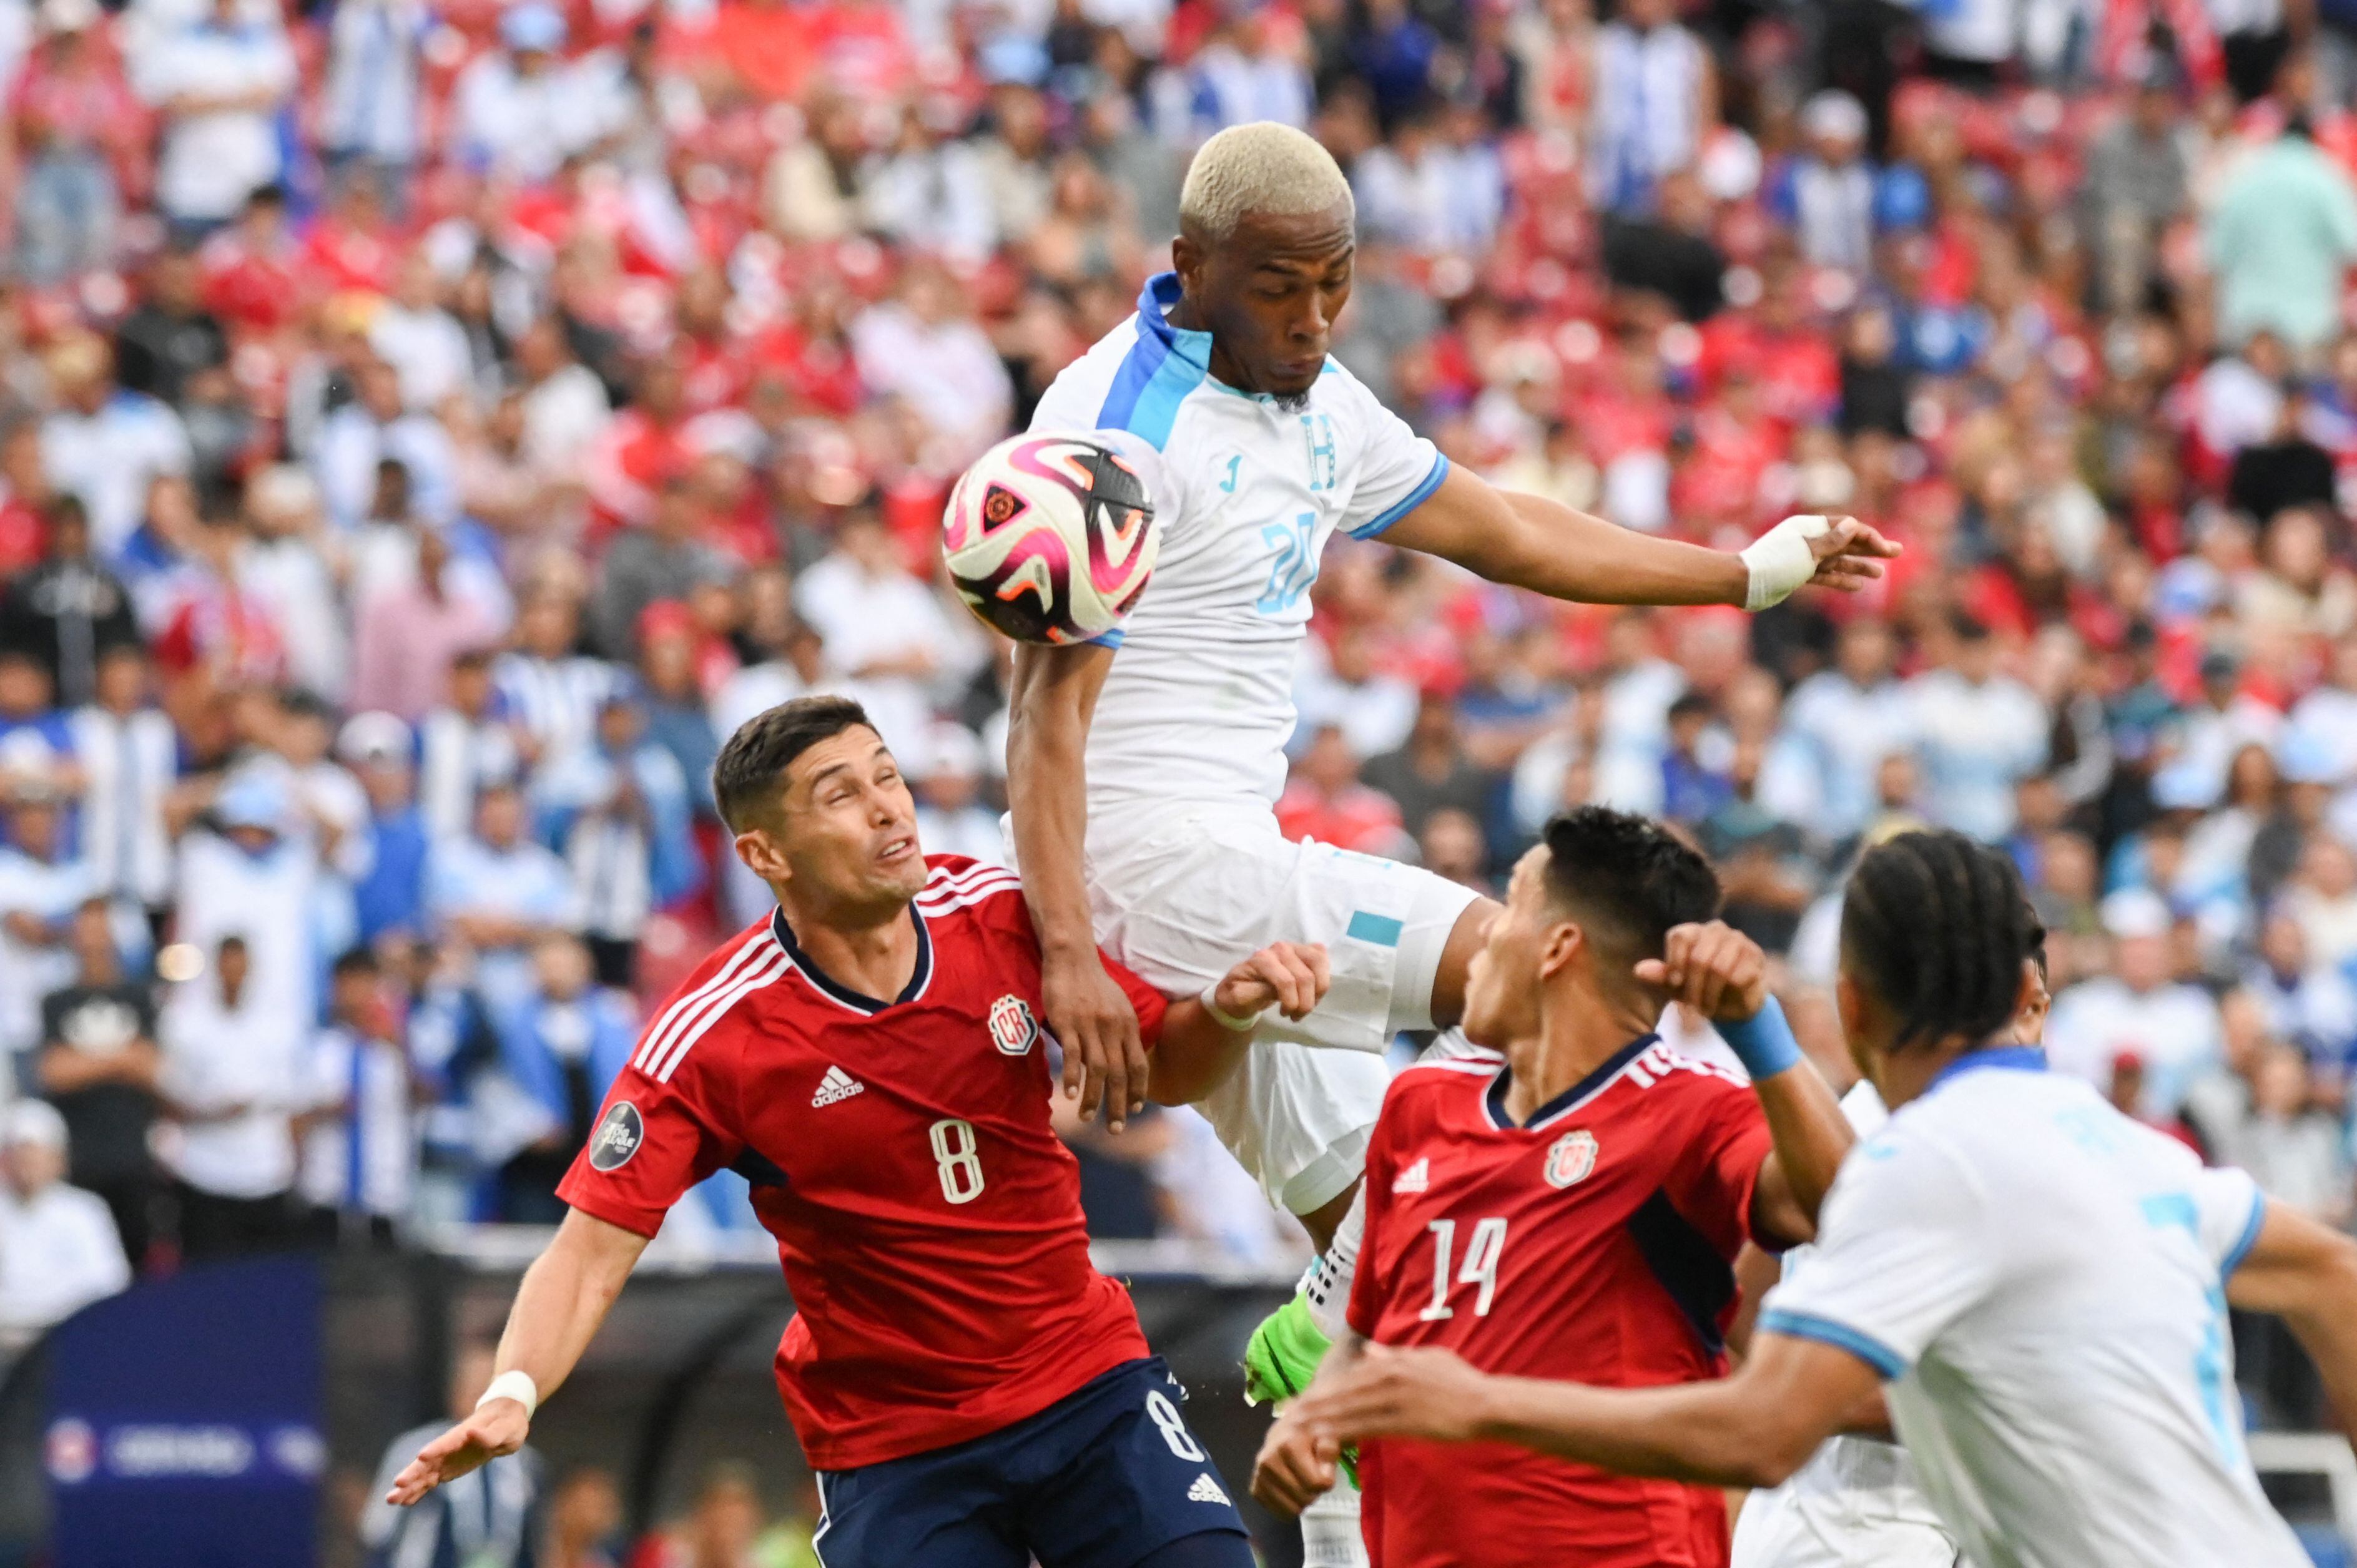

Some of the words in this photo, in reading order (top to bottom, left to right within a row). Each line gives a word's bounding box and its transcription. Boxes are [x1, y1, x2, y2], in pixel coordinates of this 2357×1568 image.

[1300, 414, 1335, 491] H
[1257, 512, 1317, 614] 20
[997, 1007, 1027, 1044] CR
[811, 1081, 865, 1109] adidas
[929, 1119, 985, 1205] 8
[1419, 1217, 1508, 1321] 14
[1146, 1389, 1205, 1463] 8
